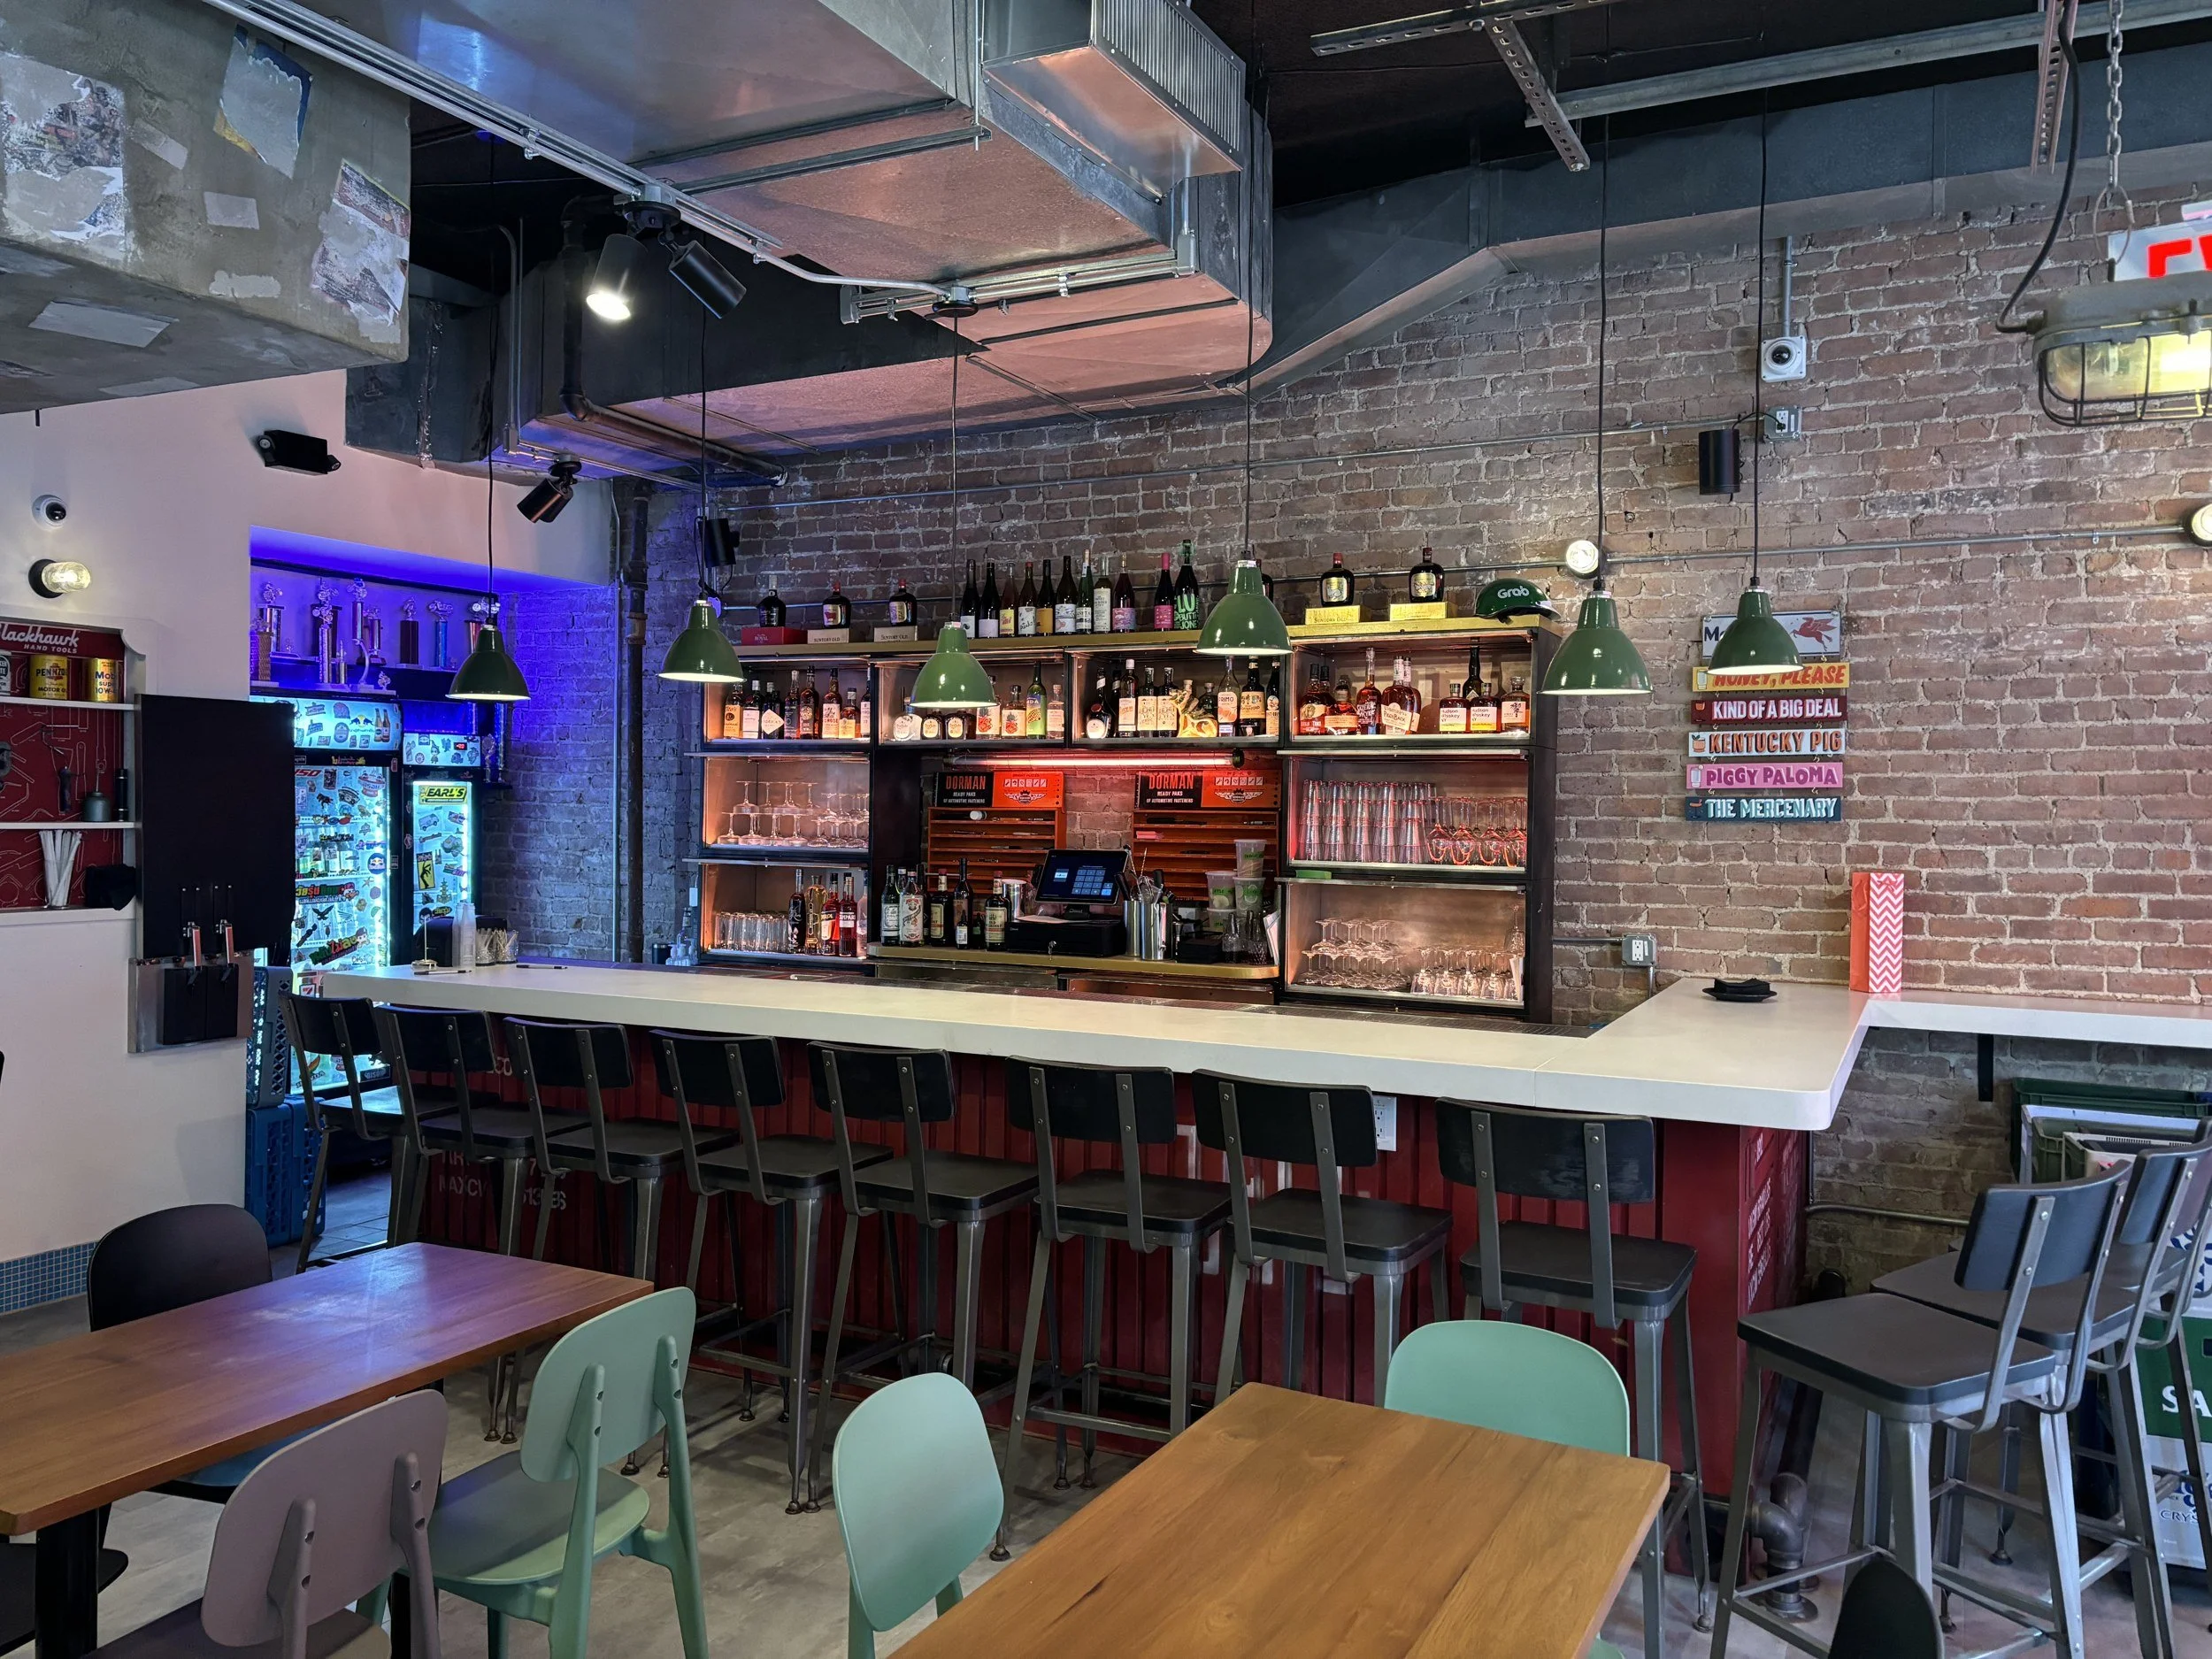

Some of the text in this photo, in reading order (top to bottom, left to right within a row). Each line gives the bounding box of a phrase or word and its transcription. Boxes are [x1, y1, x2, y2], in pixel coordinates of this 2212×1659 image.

[1497, 586, 1529, 599] Grab
[0, 622, 80, 648] lackhawk
[1780, 664, 1847, 685] PLEASE
[1712, 698, 1842, 720] KIND OF A BIG DEAL
[1709, 731, 1842, 753] KENTUCKY PIG
[946, 776, 986, 790] DORMAN
[1149, 773, 1194, 789] DORMAN
[1707, 766, 1838, 786] PIGGY PALOMA
[426, 788, 465, 797] EARL'S
[1705, 797, 1838, 818] THE MERCENARY
